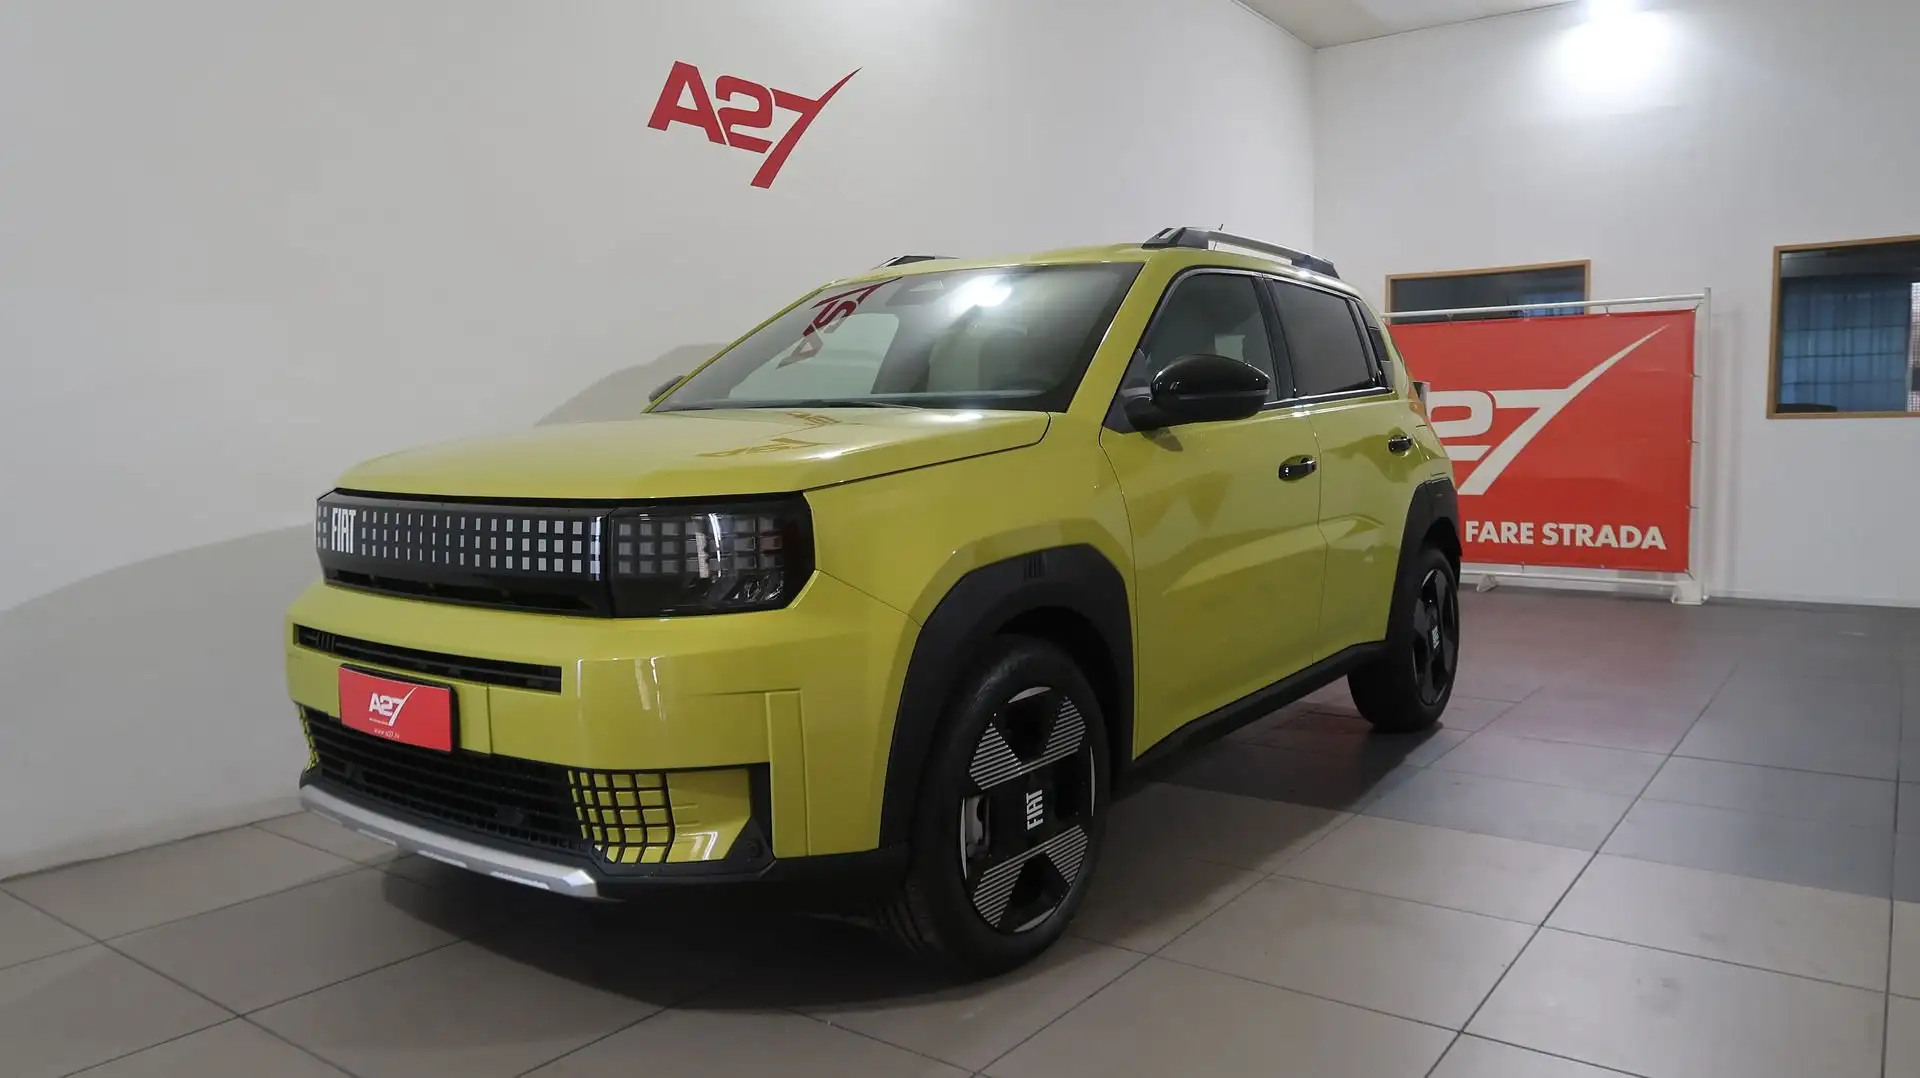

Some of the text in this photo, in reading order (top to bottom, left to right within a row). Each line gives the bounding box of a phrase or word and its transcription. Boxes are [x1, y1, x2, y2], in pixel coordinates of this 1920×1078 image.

[647, 60, 864, 189] A27
[331, 507, 357, 554] FIAT
[1465, 520, 1667, 550] FARE STRADA
[368, 686, 419, 727] A27
[1026, 789, 1044, 830] FIAT
